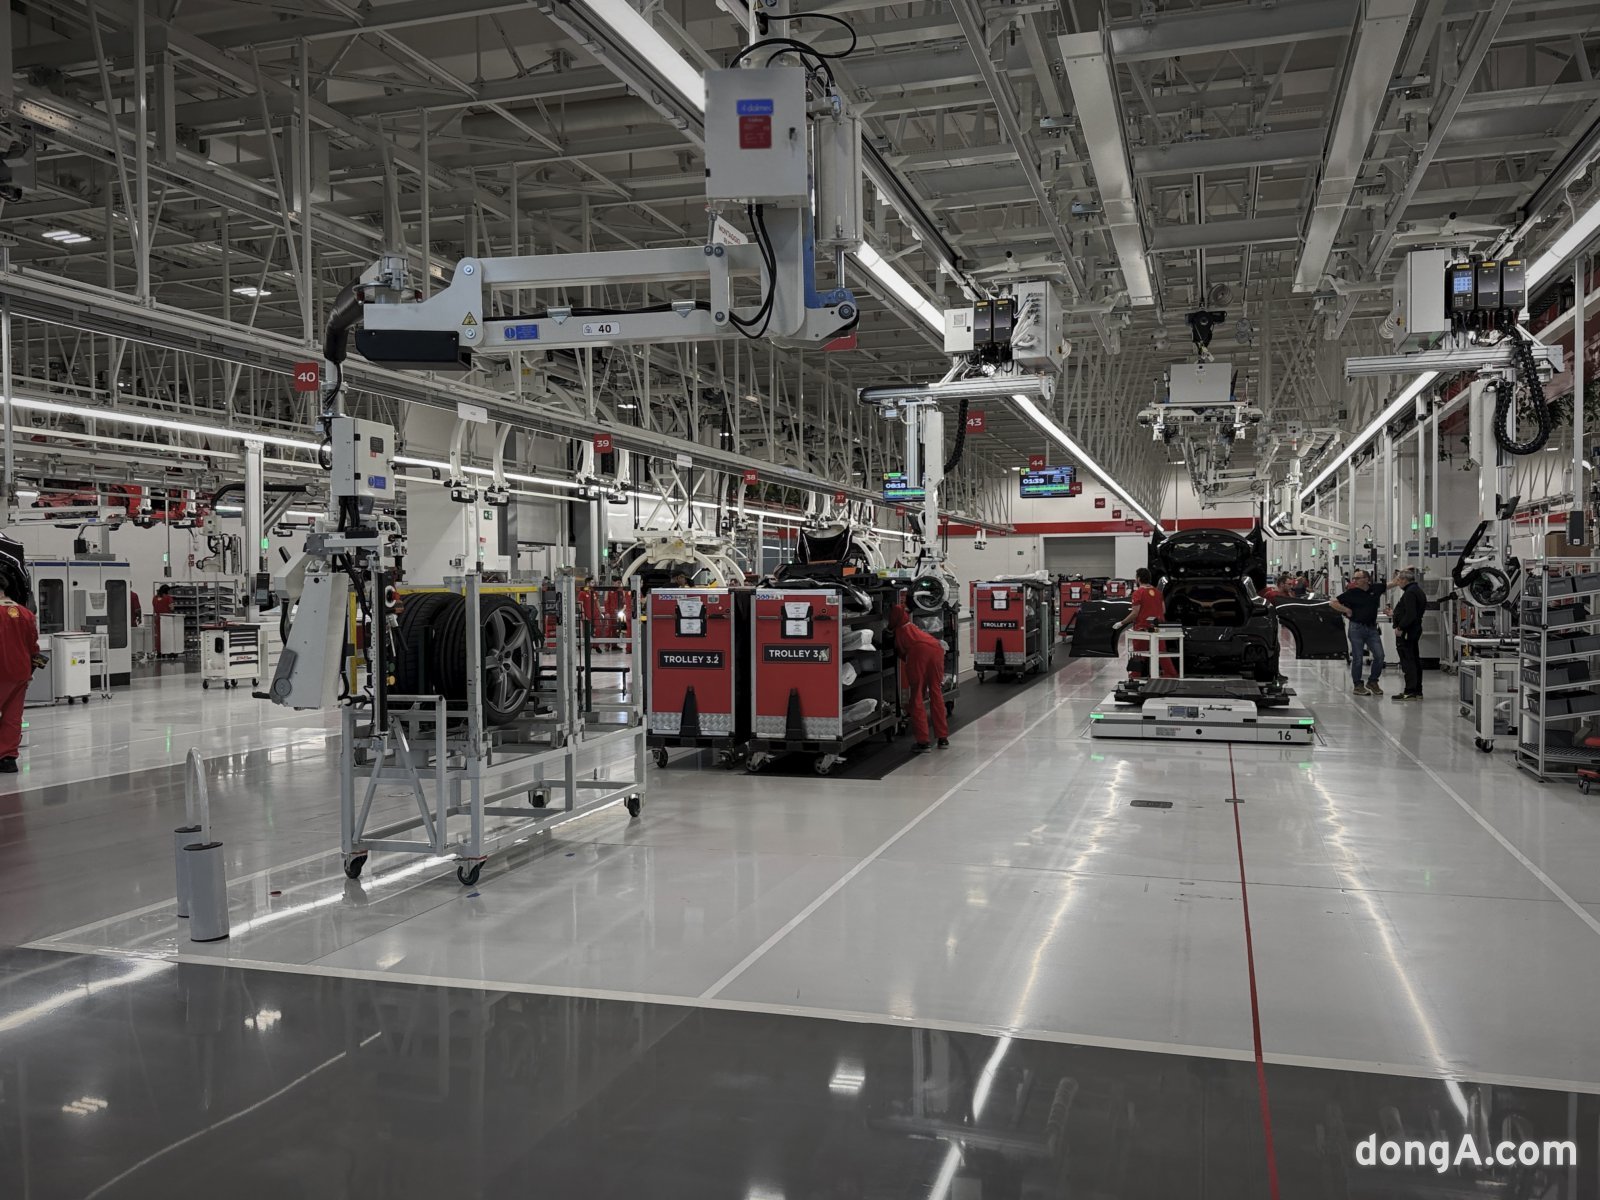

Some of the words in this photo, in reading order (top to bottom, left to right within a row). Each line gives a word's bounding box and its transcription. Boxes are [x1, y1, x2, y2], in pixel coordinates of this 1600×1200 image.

[598, 324, 612, 334] 40
[297, 371, 316, 383] 40
[966, 417, 982, 426] 43
[596, 439, 610, 448] 39
[769, 649, 811, 658] TROLLEY
[664, 655, 704, 664] TROLLEY
[706, 655, 719, 664] 3.2
[1277, 730, 1292, 741] 16
